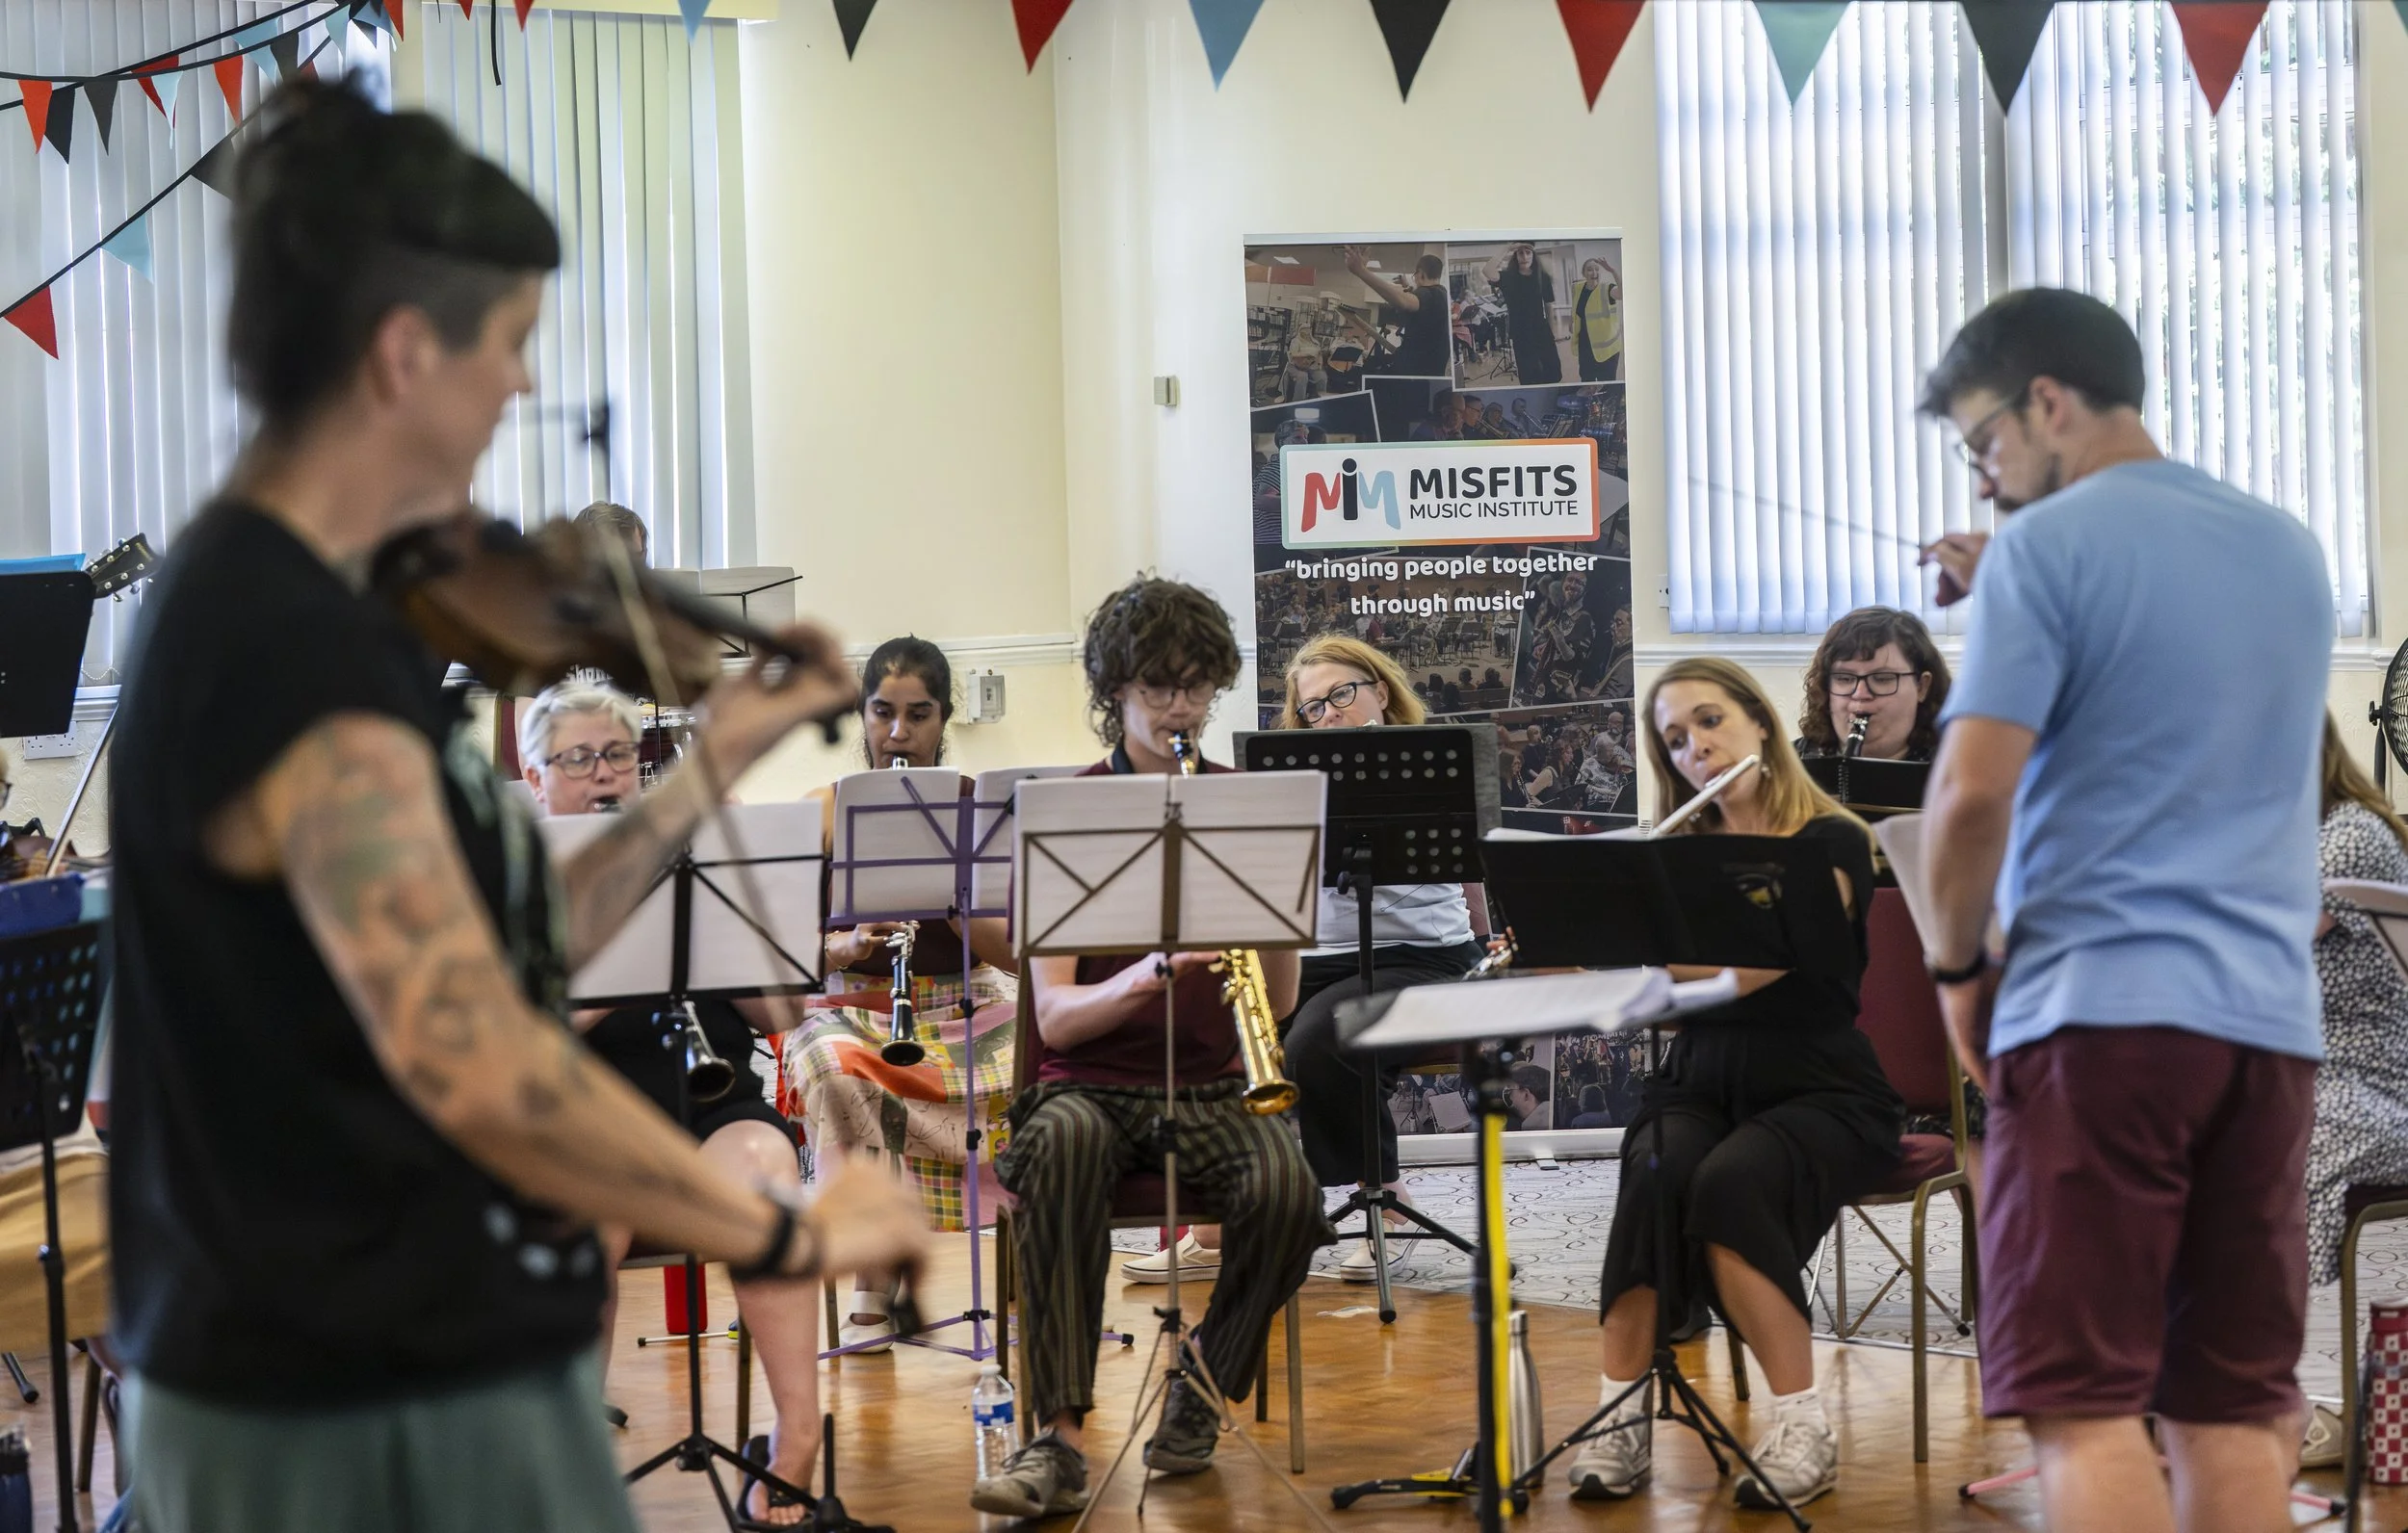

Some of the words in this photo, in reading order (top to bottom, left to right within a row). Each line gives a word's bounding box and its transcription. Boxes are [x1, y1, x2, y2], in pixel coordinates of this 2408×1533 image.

[1409, 464, 1578, 501] MISFITS
[1409, 502, 1473, 520] MUSIC
[1478, 500, 1579, 518] INSTITUTE
[1404, 555, 1487, 581] people
[1492, 552, 1598, 578] together
[1350, 592, 1448, 617] through
